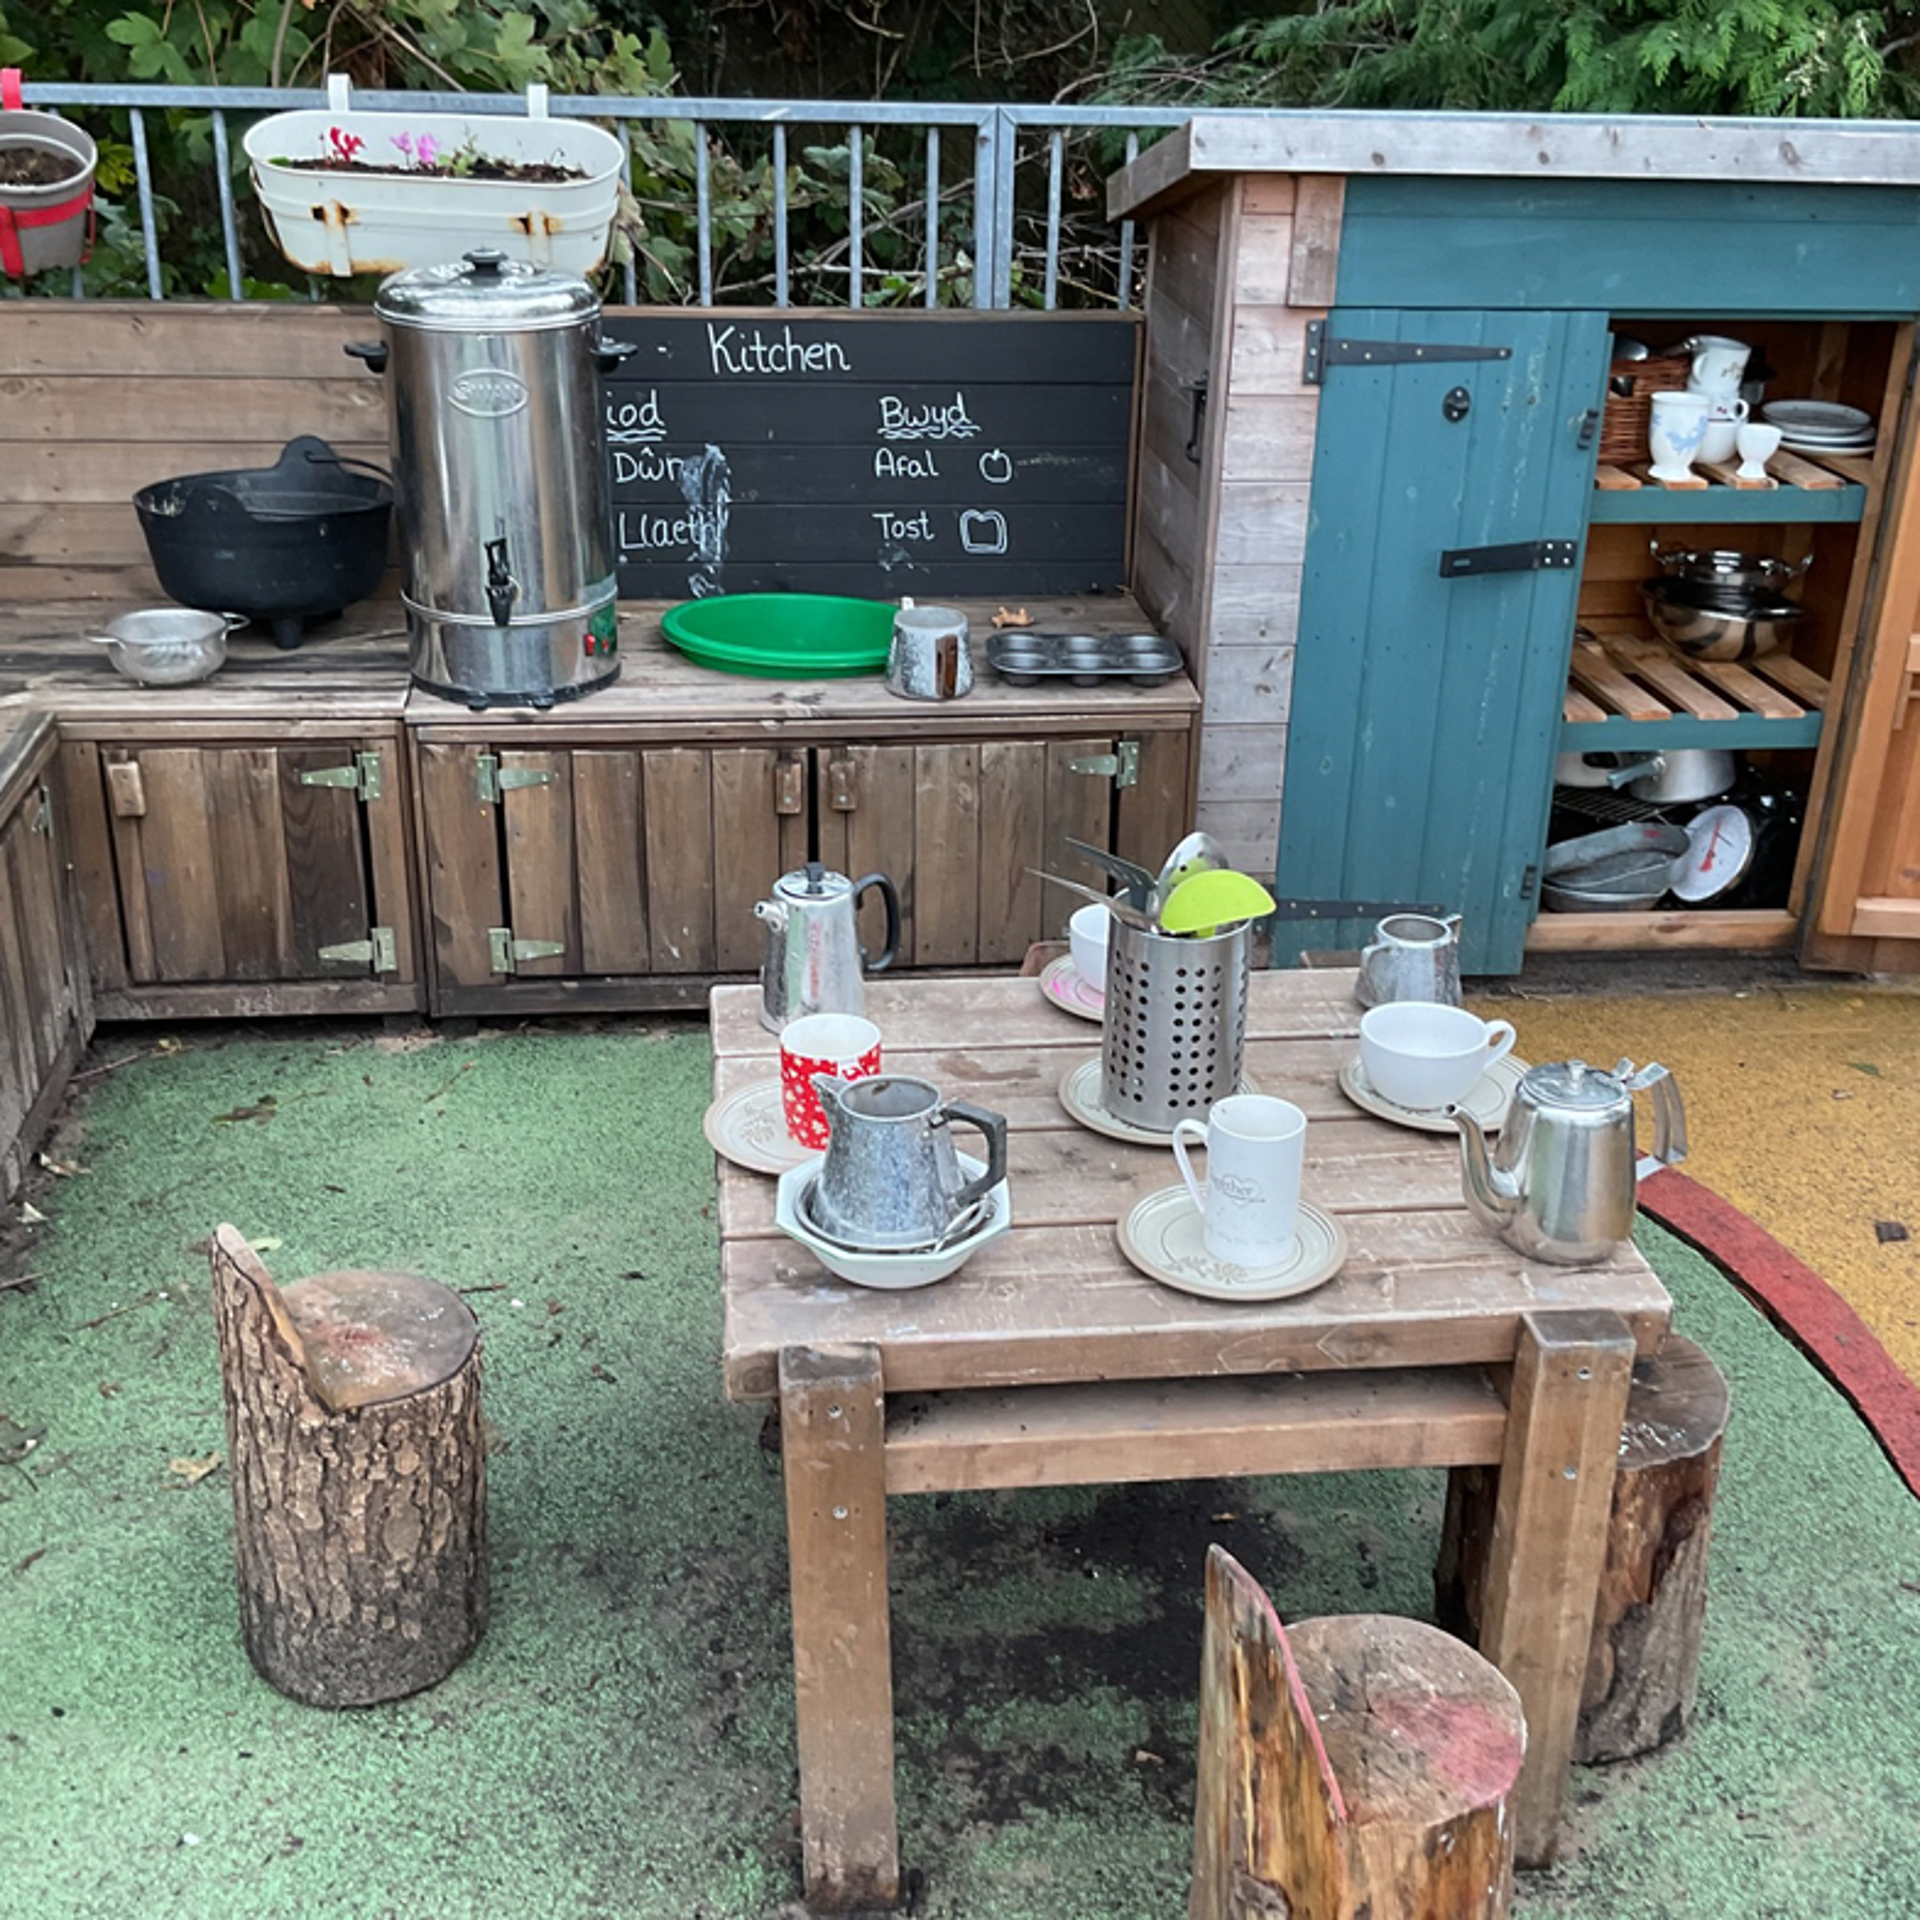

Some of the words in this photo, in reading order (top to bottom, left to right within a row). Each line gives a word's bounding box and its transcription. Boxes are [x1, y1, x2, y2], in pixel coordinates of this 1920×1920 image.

[706, 322, 851, 375] Kitchen
[606, 388, 666, 428] iod
[879, 390, 972, 439] Bwyd
[874, 447, 939, 478] Afal
[871, 510, 935, 541] Tost
